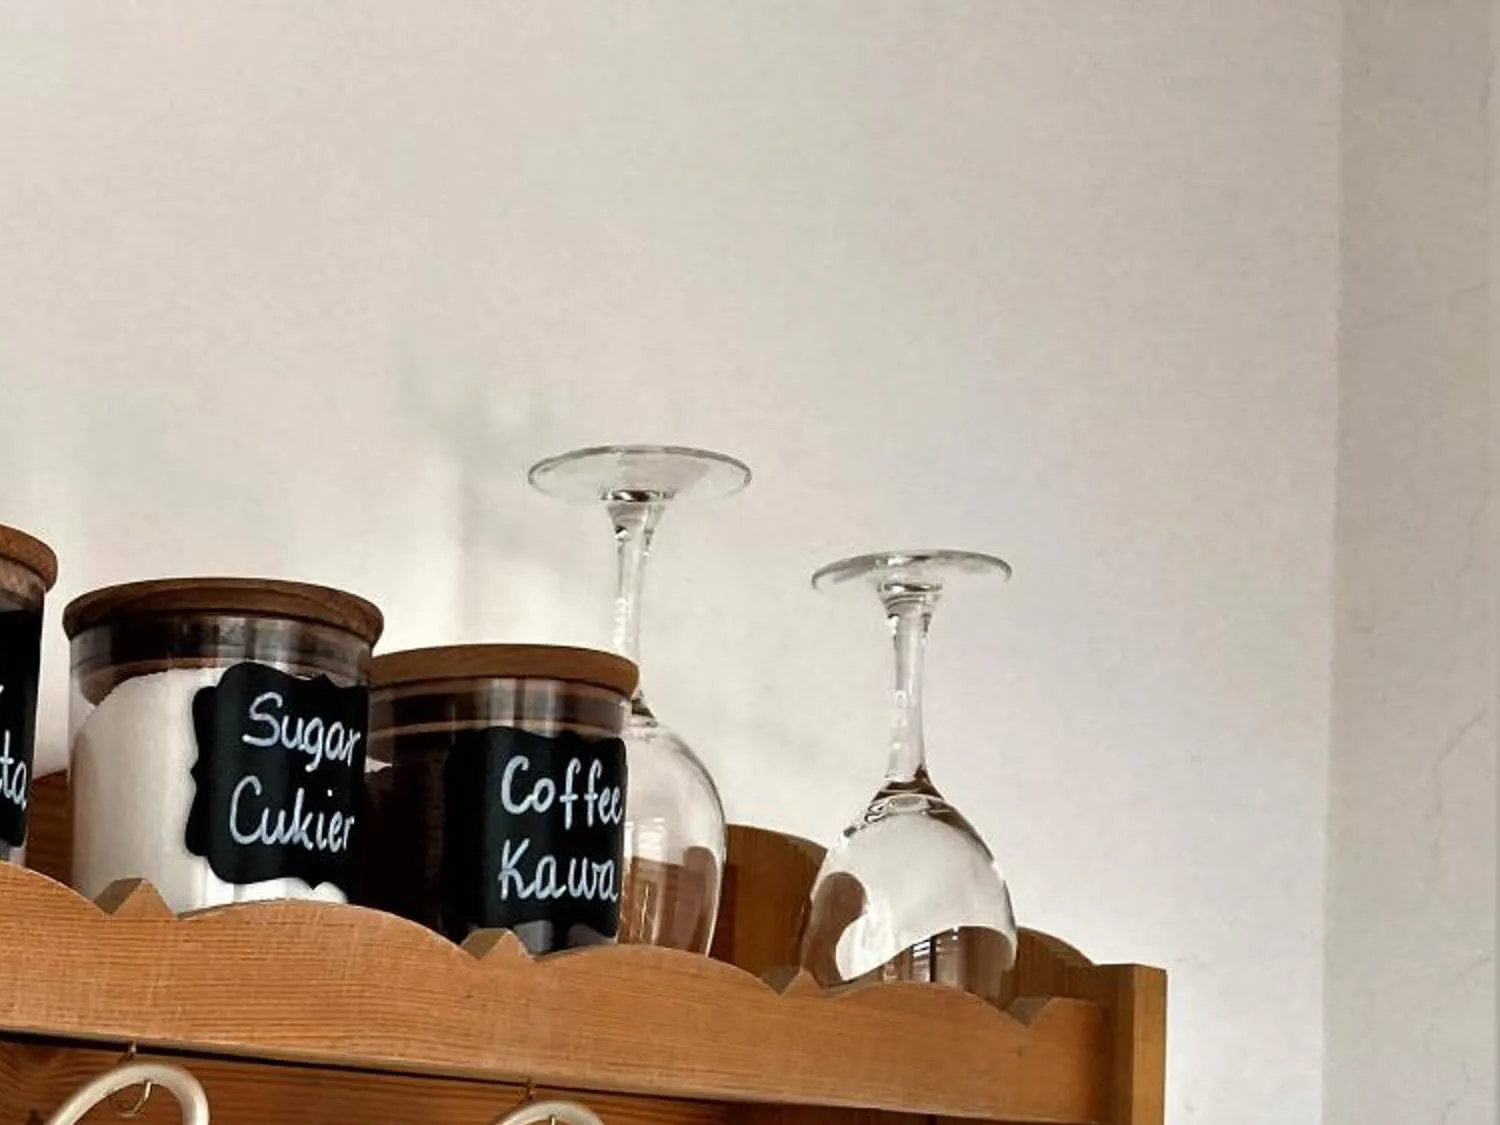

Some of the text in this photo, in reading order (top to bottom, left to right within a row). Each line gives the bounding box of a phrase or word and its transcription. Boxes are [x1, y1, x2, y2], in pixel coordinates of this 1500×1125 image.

[242, 692, 361, 773] Sugar
[229, 775, 355, 853] Cukier
[501, 755, 623, 830] Coffee
[498, 838, 618, 902] Kawa
